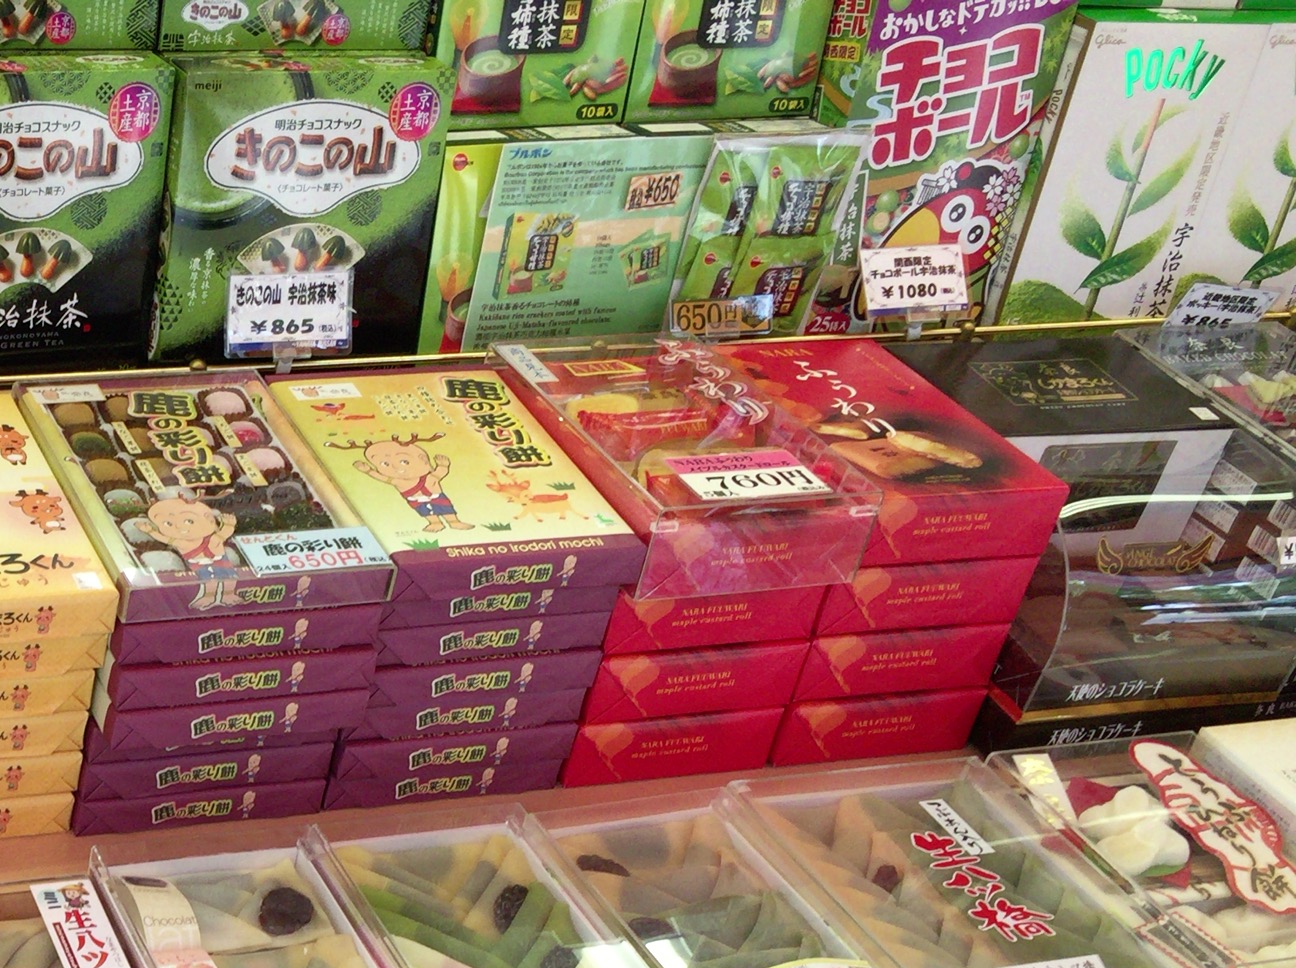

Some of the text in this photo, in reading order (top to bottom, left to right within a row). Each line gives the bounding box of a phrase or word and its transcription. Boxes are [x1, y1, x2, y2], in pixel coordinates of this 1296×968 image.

[879, 25, 1044, 104] チョコ
[1124, 38, 1226, 101] POCKY
[194, 80, 222, 91] meiji
[275, 118, 362, 131] 明治チョコスナック
[867, 87, 1034, 169] ボール
[230, 125, 396, 181] きのこの山
[510, 148, 553, 159] ブルボン
[870, 264, 957, 279] チョコボール宇治抹茶
[893, 255, 932, 268] 関西限定
[1145, 222, 1194, 318] 宇治抹茶
[237, 284, 282, 306] きのこの山
[881, 283, 938, 299] ¥1080
[251, 317, 314, 335] ¥865
[0, 340, 39, 350] GREEN
[43, 338, 64, 348] TEA
[445, 378, 553, 468] 鹿の彩り餅
[133, 393, 227, 485] 鹿の彩り餅
[706, 468, 813, 490] 760円
[240, 533, 298, 545] せんとくん
[263, 537, 364, 557] 鹿の彩り餅
[446, 537, 604, 559] Shika no irodori mochi
[289, 551, 364, 570] 650円
[471, 563, 552, 589] 鹿の彩り餅
